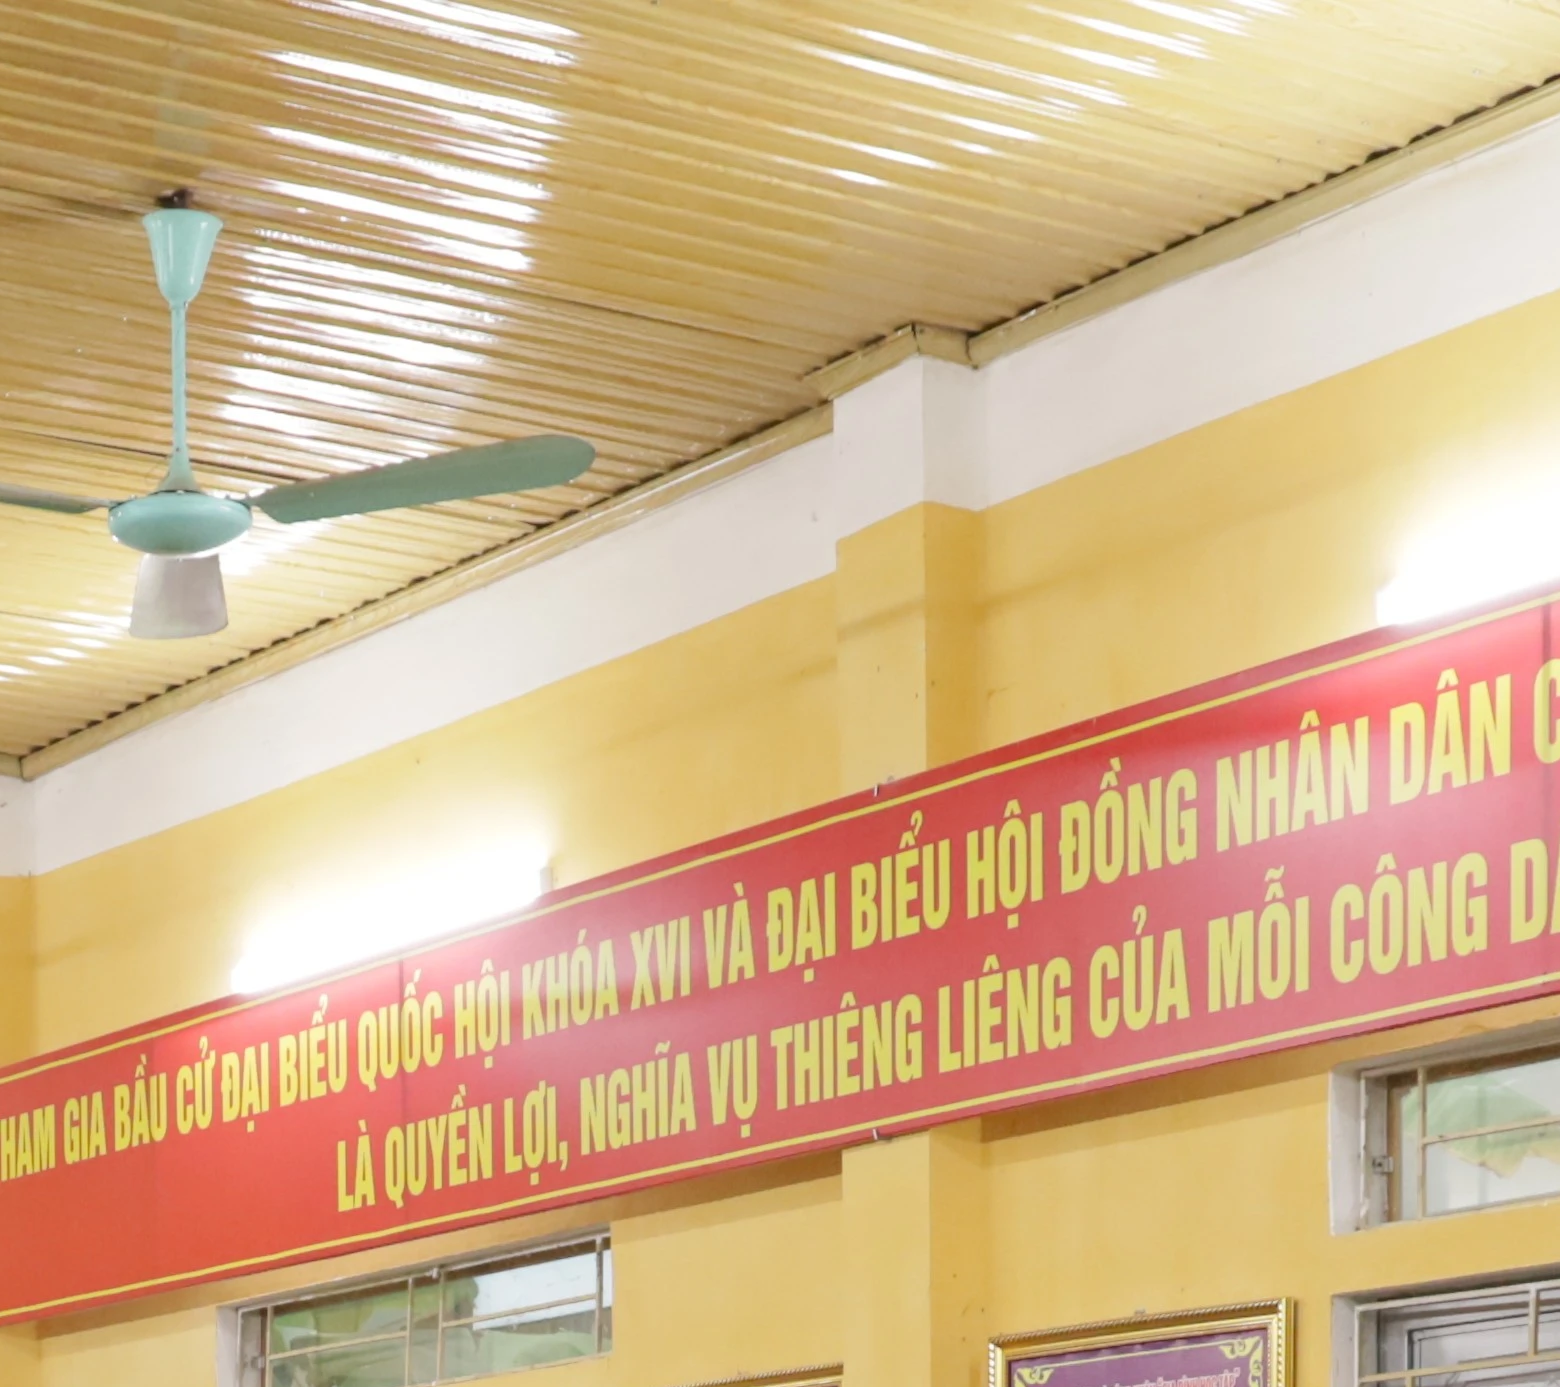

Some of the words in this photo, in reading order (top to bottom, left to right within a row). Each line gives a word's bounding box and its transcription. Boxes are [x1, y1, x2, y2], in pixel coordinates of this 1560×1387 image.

[64, 1091, 107, 1164] GIA
[114, 1056, 168, 1152] BẦU
[176, 1037, 216, 1134] CỬ
[221, 1042, 270, 1132] ĐẠI
[280, 994, 347, 1107] BIỂU
[358, 969, 443, 1091] QUỐC
[454, 959, 509, 1069] HỘI
[522, 930, 618, 1040] KHÓA
[630, 916, 690, 1018] XVI
[704, 882, 755, 989] VÀ
[766, 874, 835, 982] ĐẠI
[850, 811, 950, 950] BIỂU
[966, 799, 1043, 928] HỘI
[1058, 757, 1197, 894] ĐỒNG
[1215, 709, 1370, 853] NHÂN
[1389, 668, 1512, 808] DÂN
[337, 1120, 376, 1212] LÀ
[384, 1085, 493, 1208] QUYỀN
[503, 1080, 569, 1185] LỢI,
[580, 1040, 696, 1155] NGHĨA
[707, 1036, 758, 1136] VỤ
[771, 991, 923, 1111] THIÊNG
[938, 954, 1072, 1073] LIÊNG
[1088, 905, 1190, 1038] CỦA
[1207, 866, 1309, 1013] MỖI
[1329, 855, 1488, 984] CÔNG
